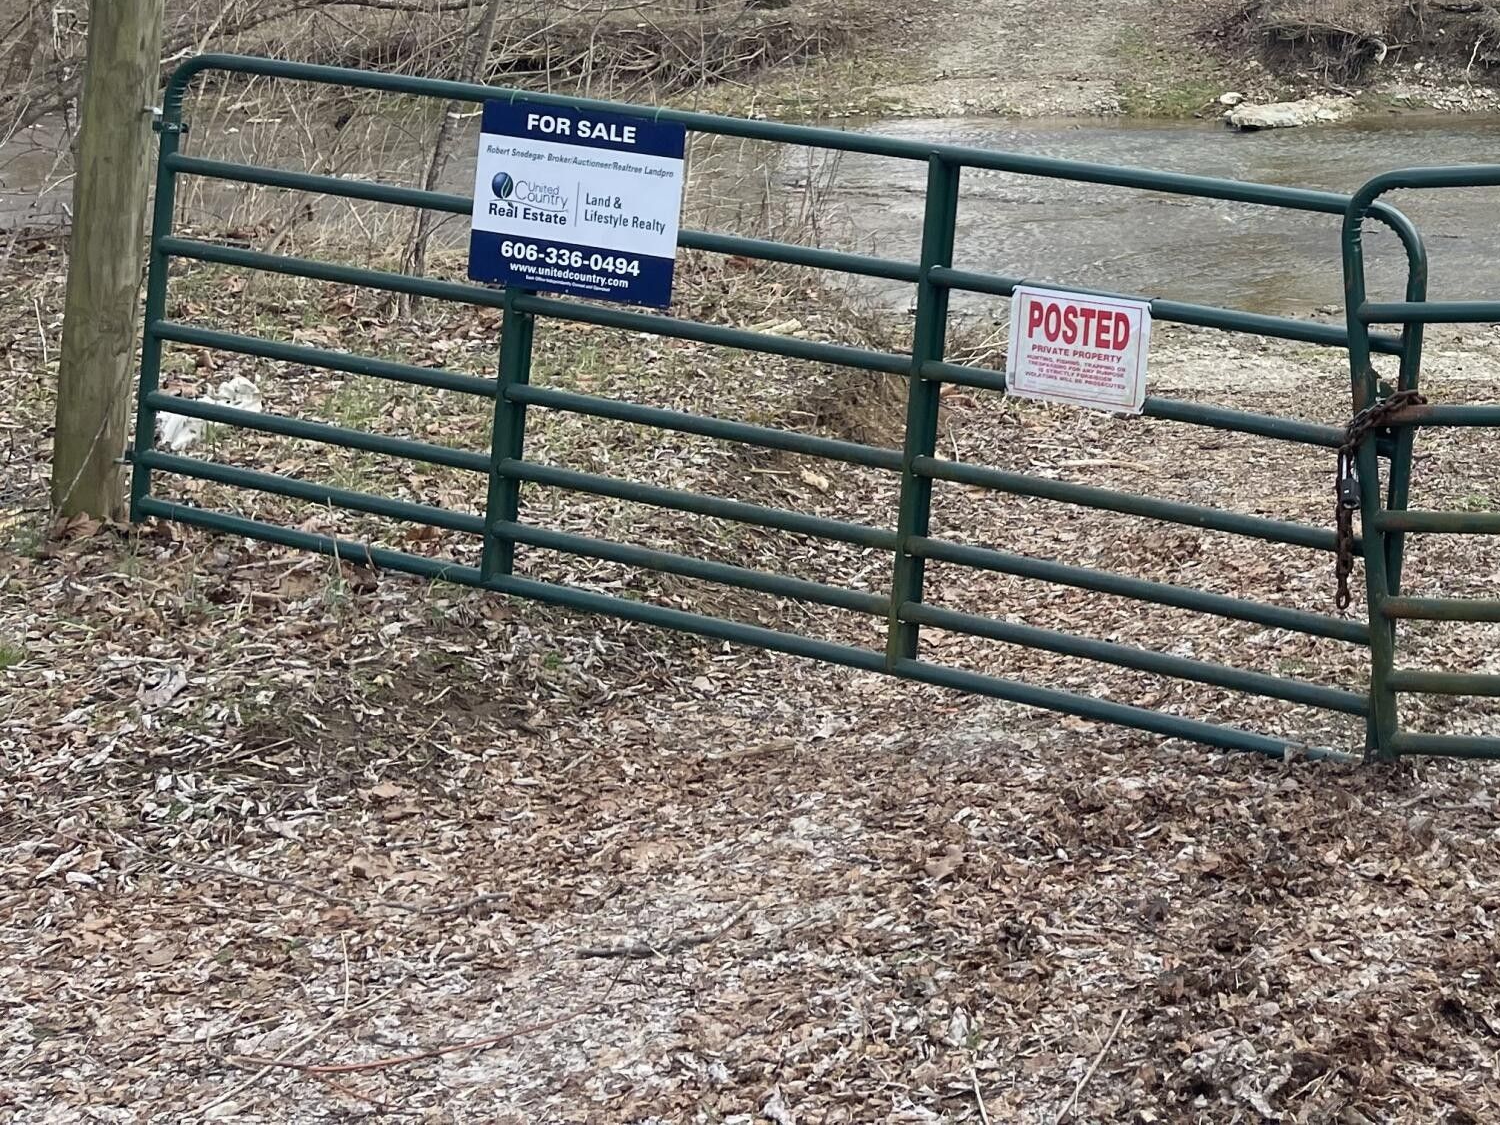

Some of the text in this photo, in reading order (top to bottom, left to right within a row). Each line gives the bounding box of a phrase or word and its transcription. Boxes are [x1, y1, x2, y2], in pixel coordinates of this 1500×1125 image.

[527, 113, 637, 144] FOR SALE
[486, 145, 510, 155] Robert
[644, 166, 674, 178] Landpro
[515, 180, 568, 209] Country
[528, 181, 560, 195] United
[585, 192, 622, 209] Land &
[488, 202, 567, 226] Real Estate
[584, 209, 666, 235] Lifestyle Realty
[501, 240, 640, 276] 606-336-0494
[510, 262, 629, 288] www.unitedcountry.com
[1027, 300, 1130, 351] POSTED
[1031, 344, 1122, 363] PRIVATE PROPERTY
